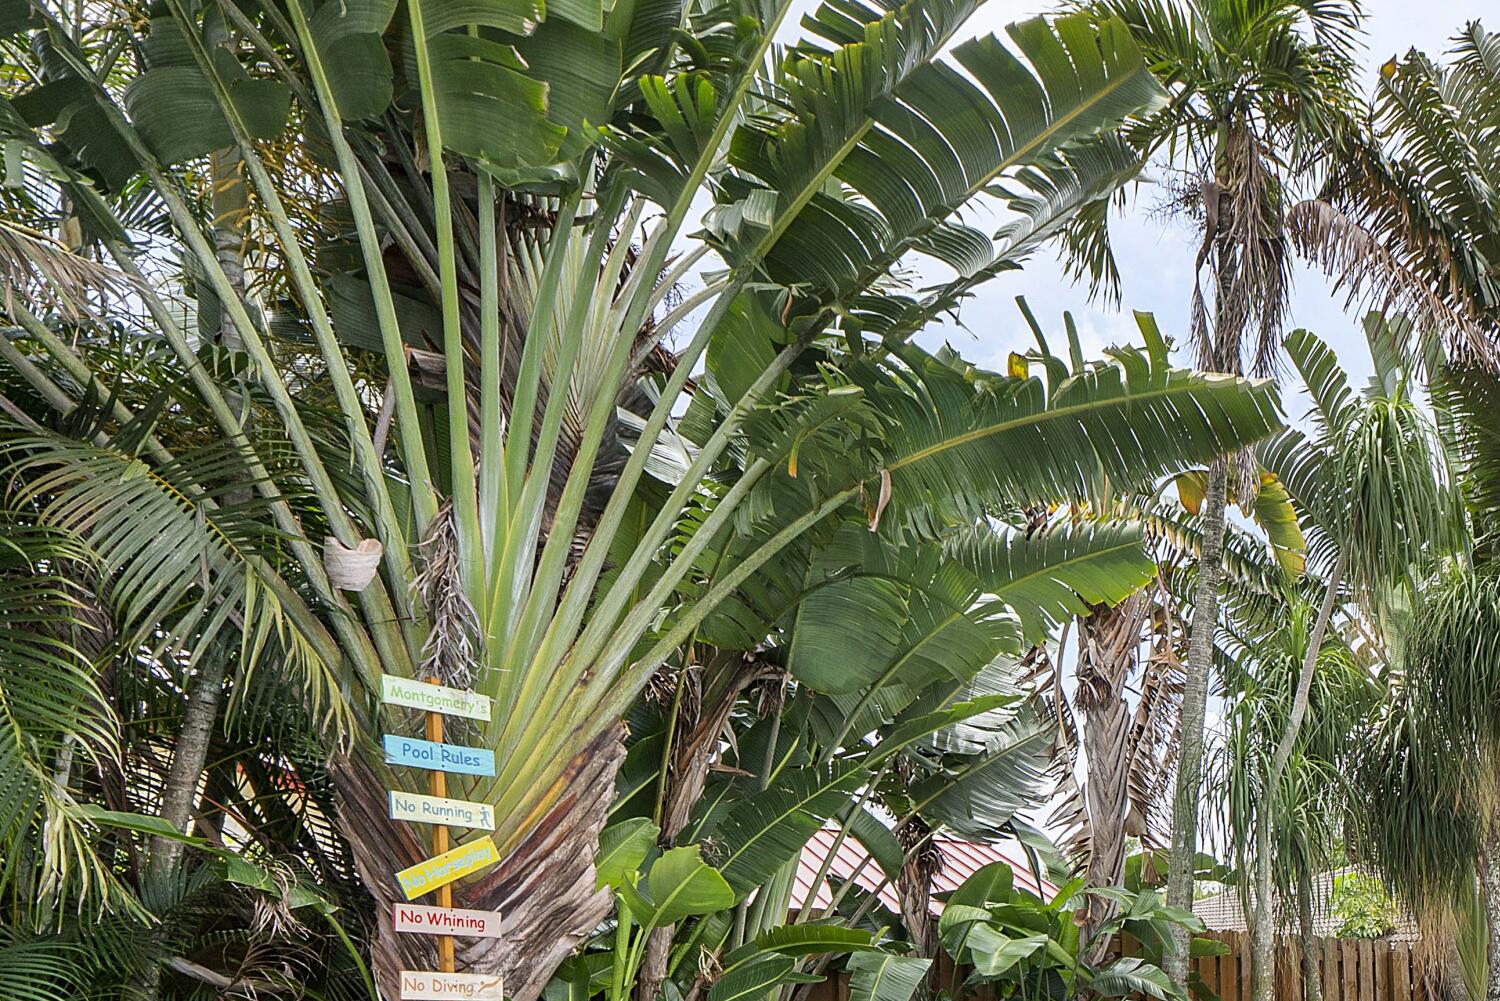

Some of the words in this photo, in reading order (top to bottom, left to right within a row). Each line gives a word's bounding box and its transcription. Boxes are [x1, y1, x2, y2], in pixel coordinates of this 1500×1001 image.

[402, 742, 434, 761] Pool
[441, 749, 480, 767] Rules
[396, 799, 416, 812] No
[423, 802, 472, 822] Running
[402, 872, 425, 891] No
[400, 910, 422, 924] No
[427, 911, 485, 932] Whining
[404, 977, 425, 991] No
[432, 979, 474, 997] Diving
